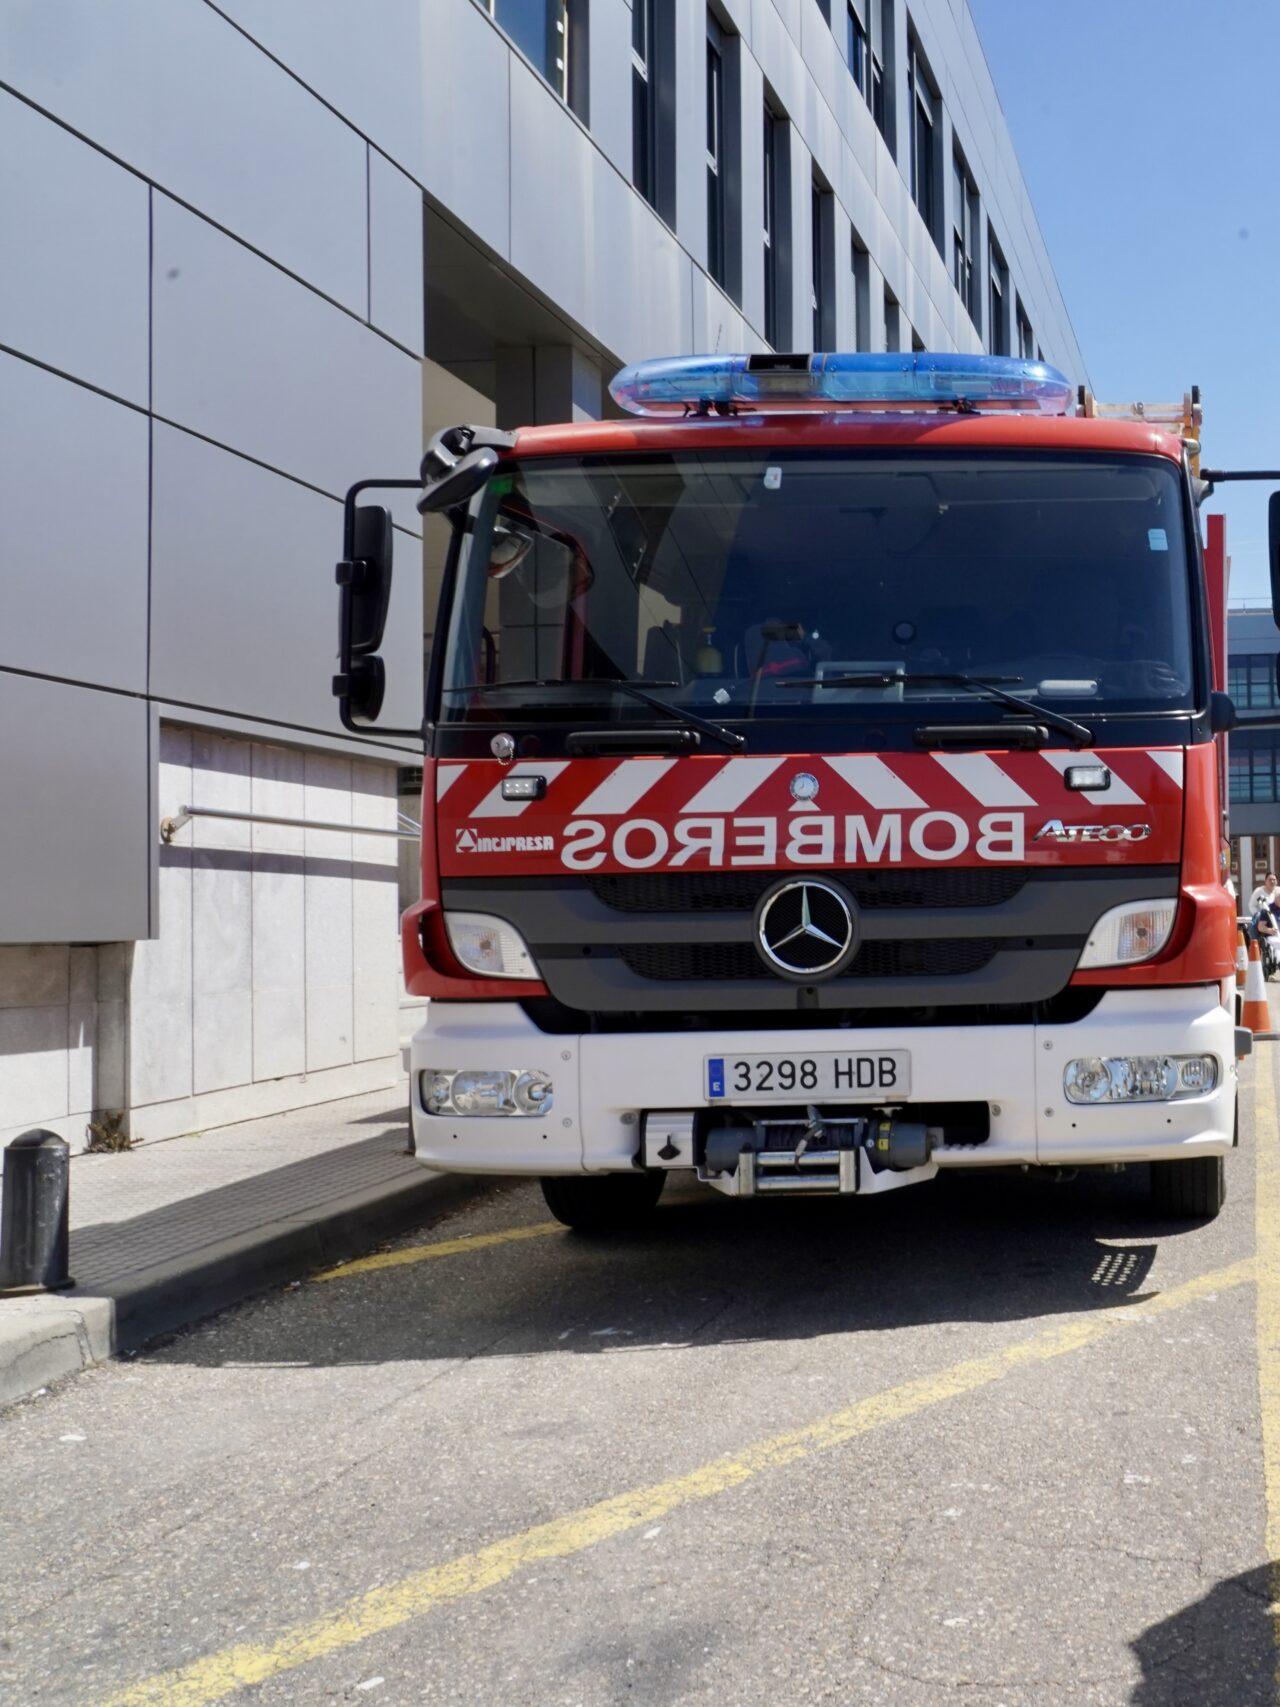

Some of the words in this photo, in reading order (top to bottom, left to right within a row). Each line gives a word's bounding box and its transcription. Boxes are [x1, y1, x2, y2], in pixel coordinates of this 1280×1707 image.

[734, 1060, 818, 1092] 3298
[834, 1057, 897, 1089] HDB
[712, 1082, 720, 1091] E
